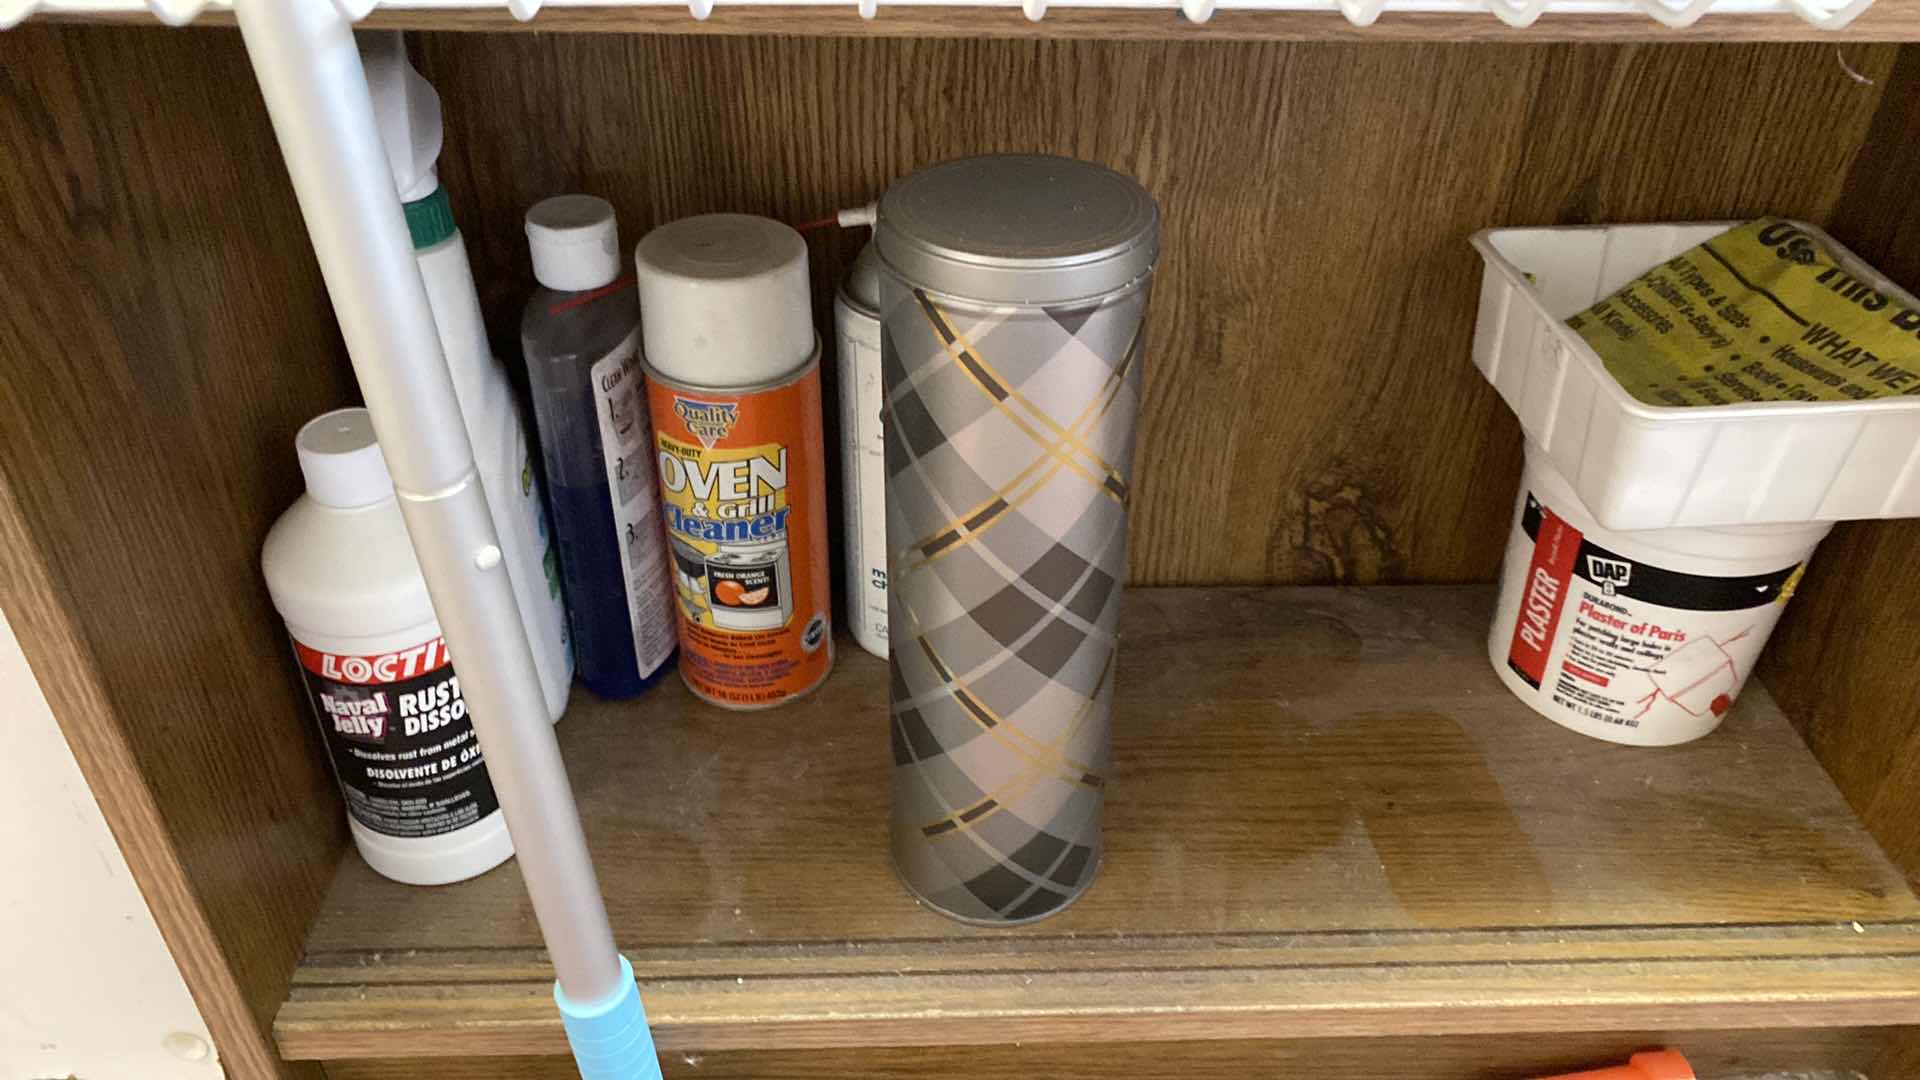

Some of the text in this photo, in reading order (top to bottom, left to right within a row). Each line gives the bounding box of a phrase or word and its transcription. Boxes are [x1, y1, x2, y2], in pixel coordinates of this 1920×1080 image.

[1801, 322, 1879, 369] WHAT
[1867, 361, 1920, 389] WE
[674, 400, 737, 424] Quality
[686, 420, 728, 437] Care
[658, 447, 787, 501] OVEN
[663, 504, 791, 541] Cleaner
[692, 494, 776, 519] & Grill
[1592, 559, 1627, 581] DAP
[1520, 567, 1561, 653] PLASTER
[1579, 600, 1687, 641] Plaster of Paris
[321, 637, 452, 683] LOCTI
[321, 691, 389, 717] Naval
[400, 676, 461, 718] RUST
[333, 714, 384, 738] Jelly
[404, 699, 470, 738] DISSO
[366, 762, 438, 781] DISOLVENTE
[442, 755, 458, 772] DE
[460, 743, 481, 763] ÓXI
[398, 749, 418, 760] rust
[419, 742, 442, 758] from
[443, 729, 469, 750] metal
